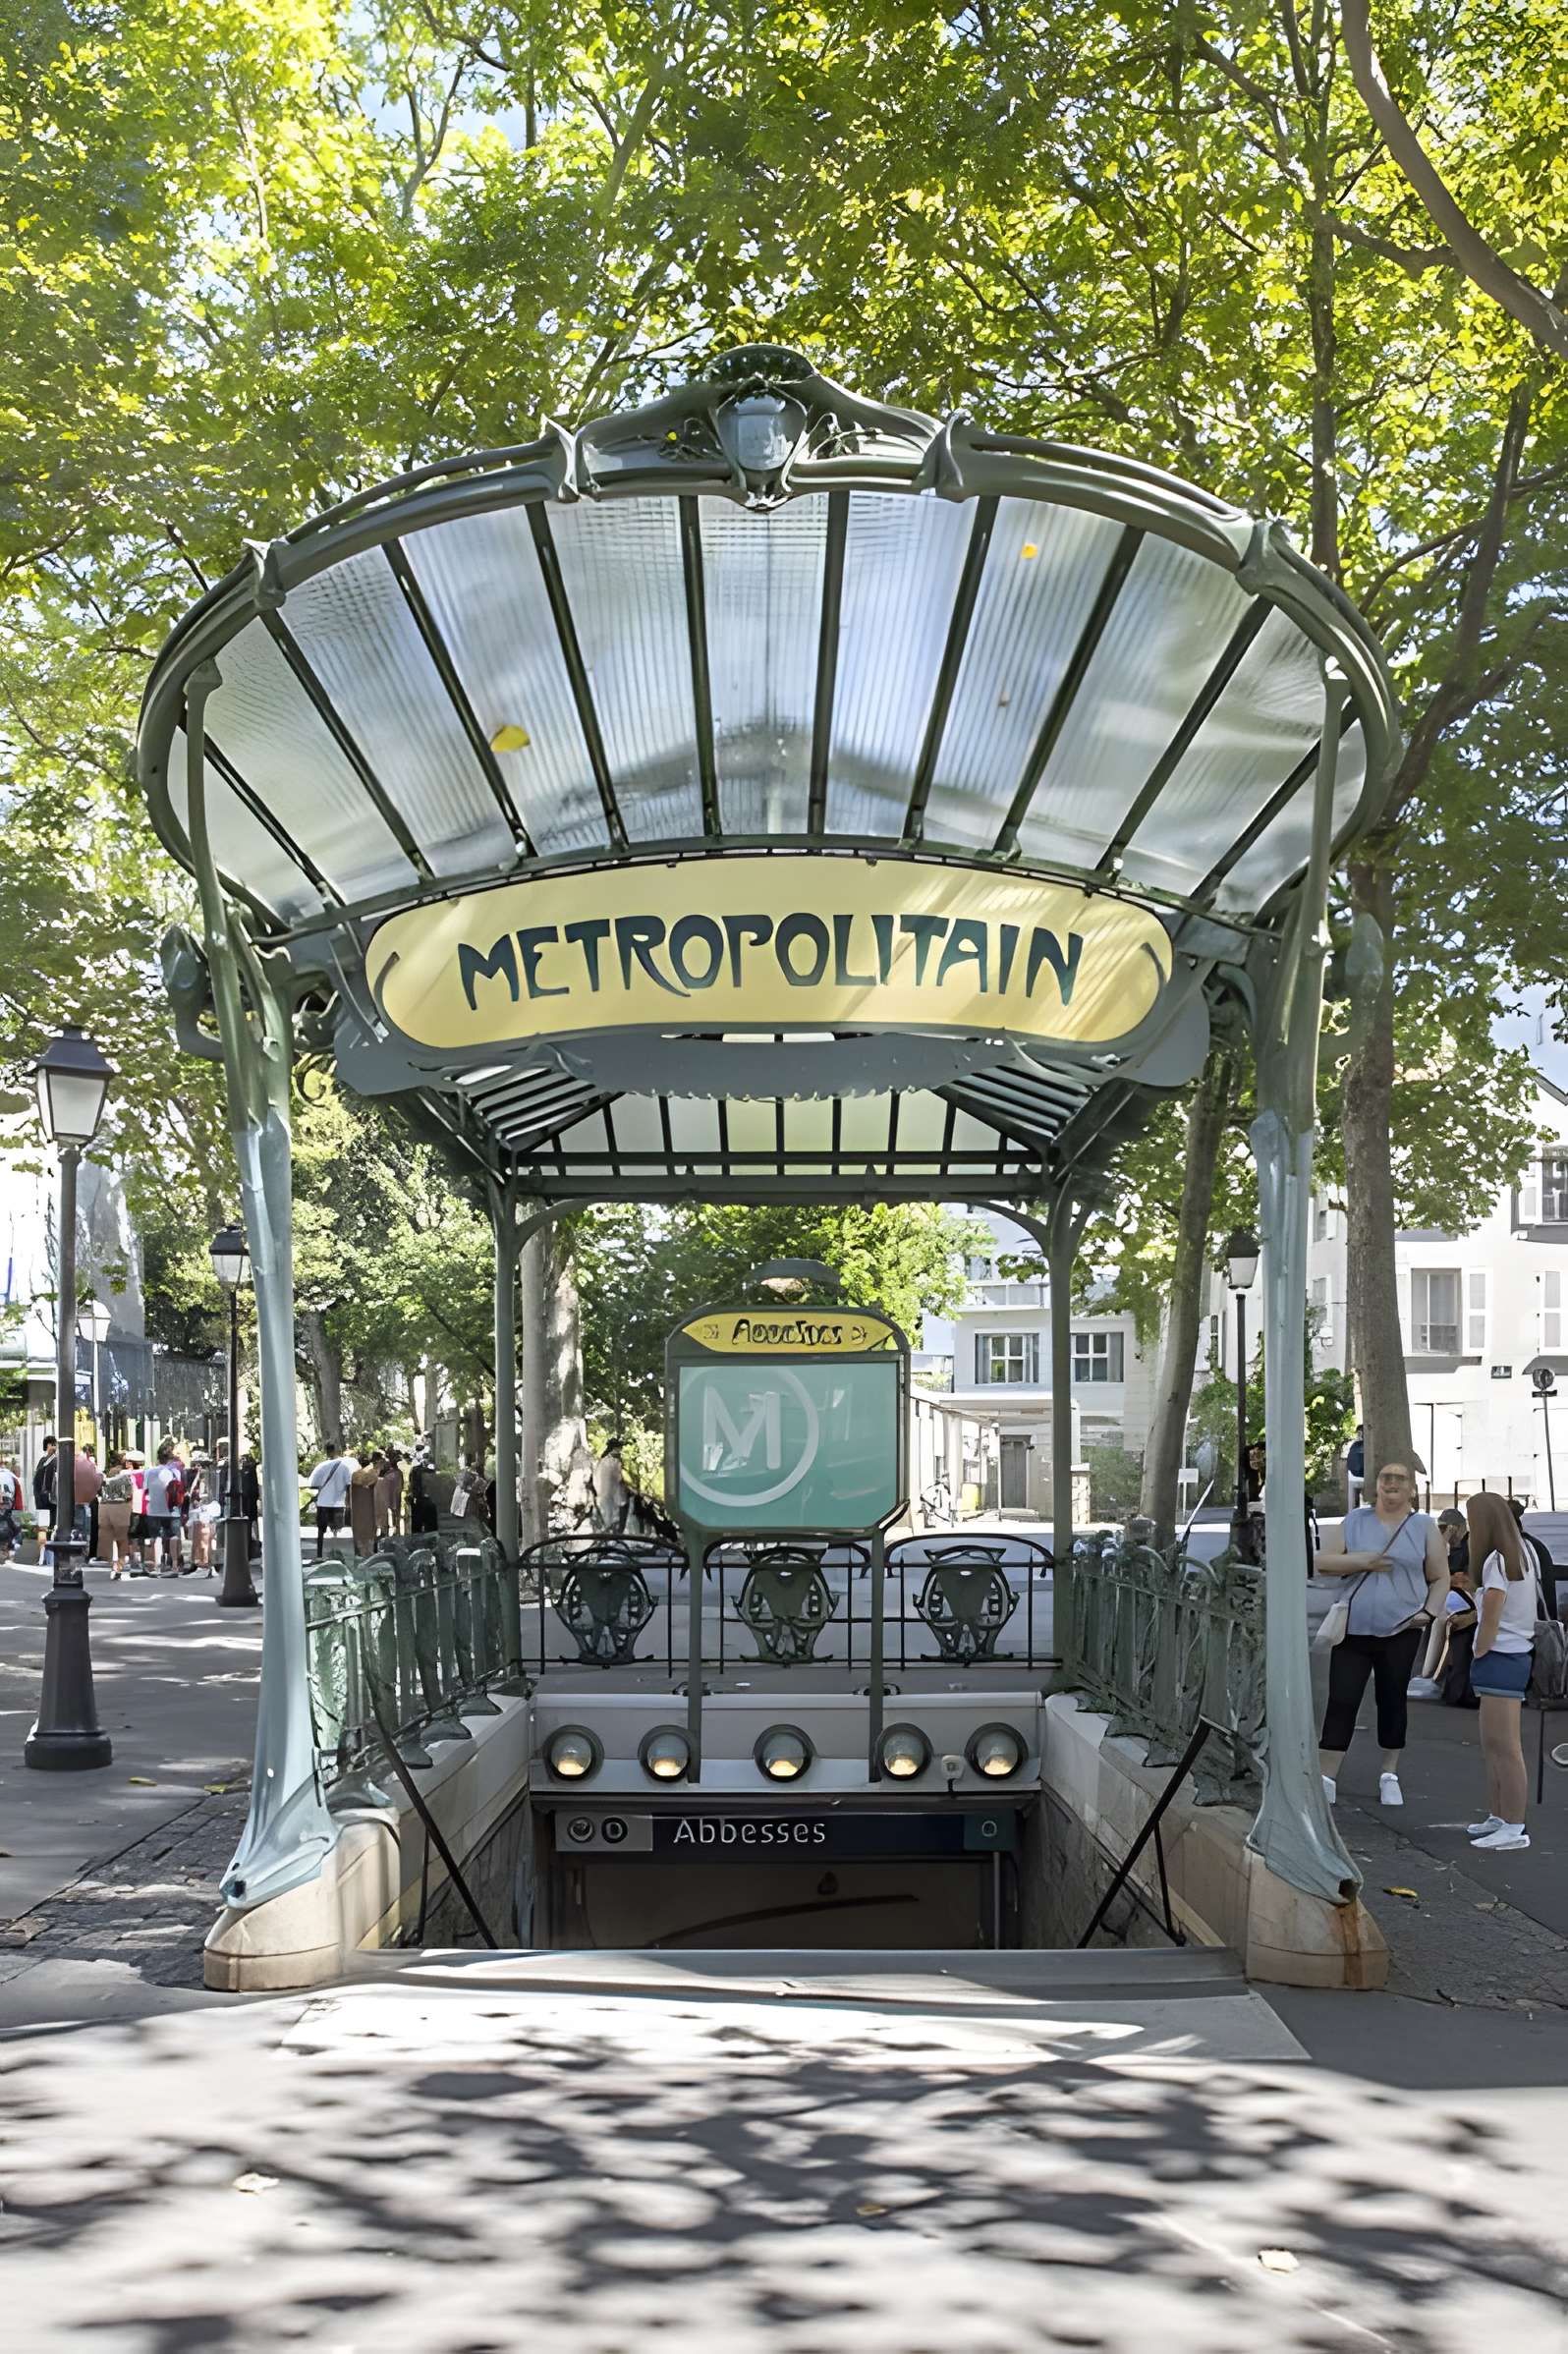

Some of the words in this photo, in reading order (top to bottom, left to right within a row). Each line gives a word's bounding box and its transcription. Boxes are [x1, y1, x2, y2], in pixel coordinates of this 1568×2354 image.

[458, 913, 1083, 1011] METROPOLITAIN
[702, 1384, 781, 1472] M
[673, 1818, 826, 1844] Abbesses
